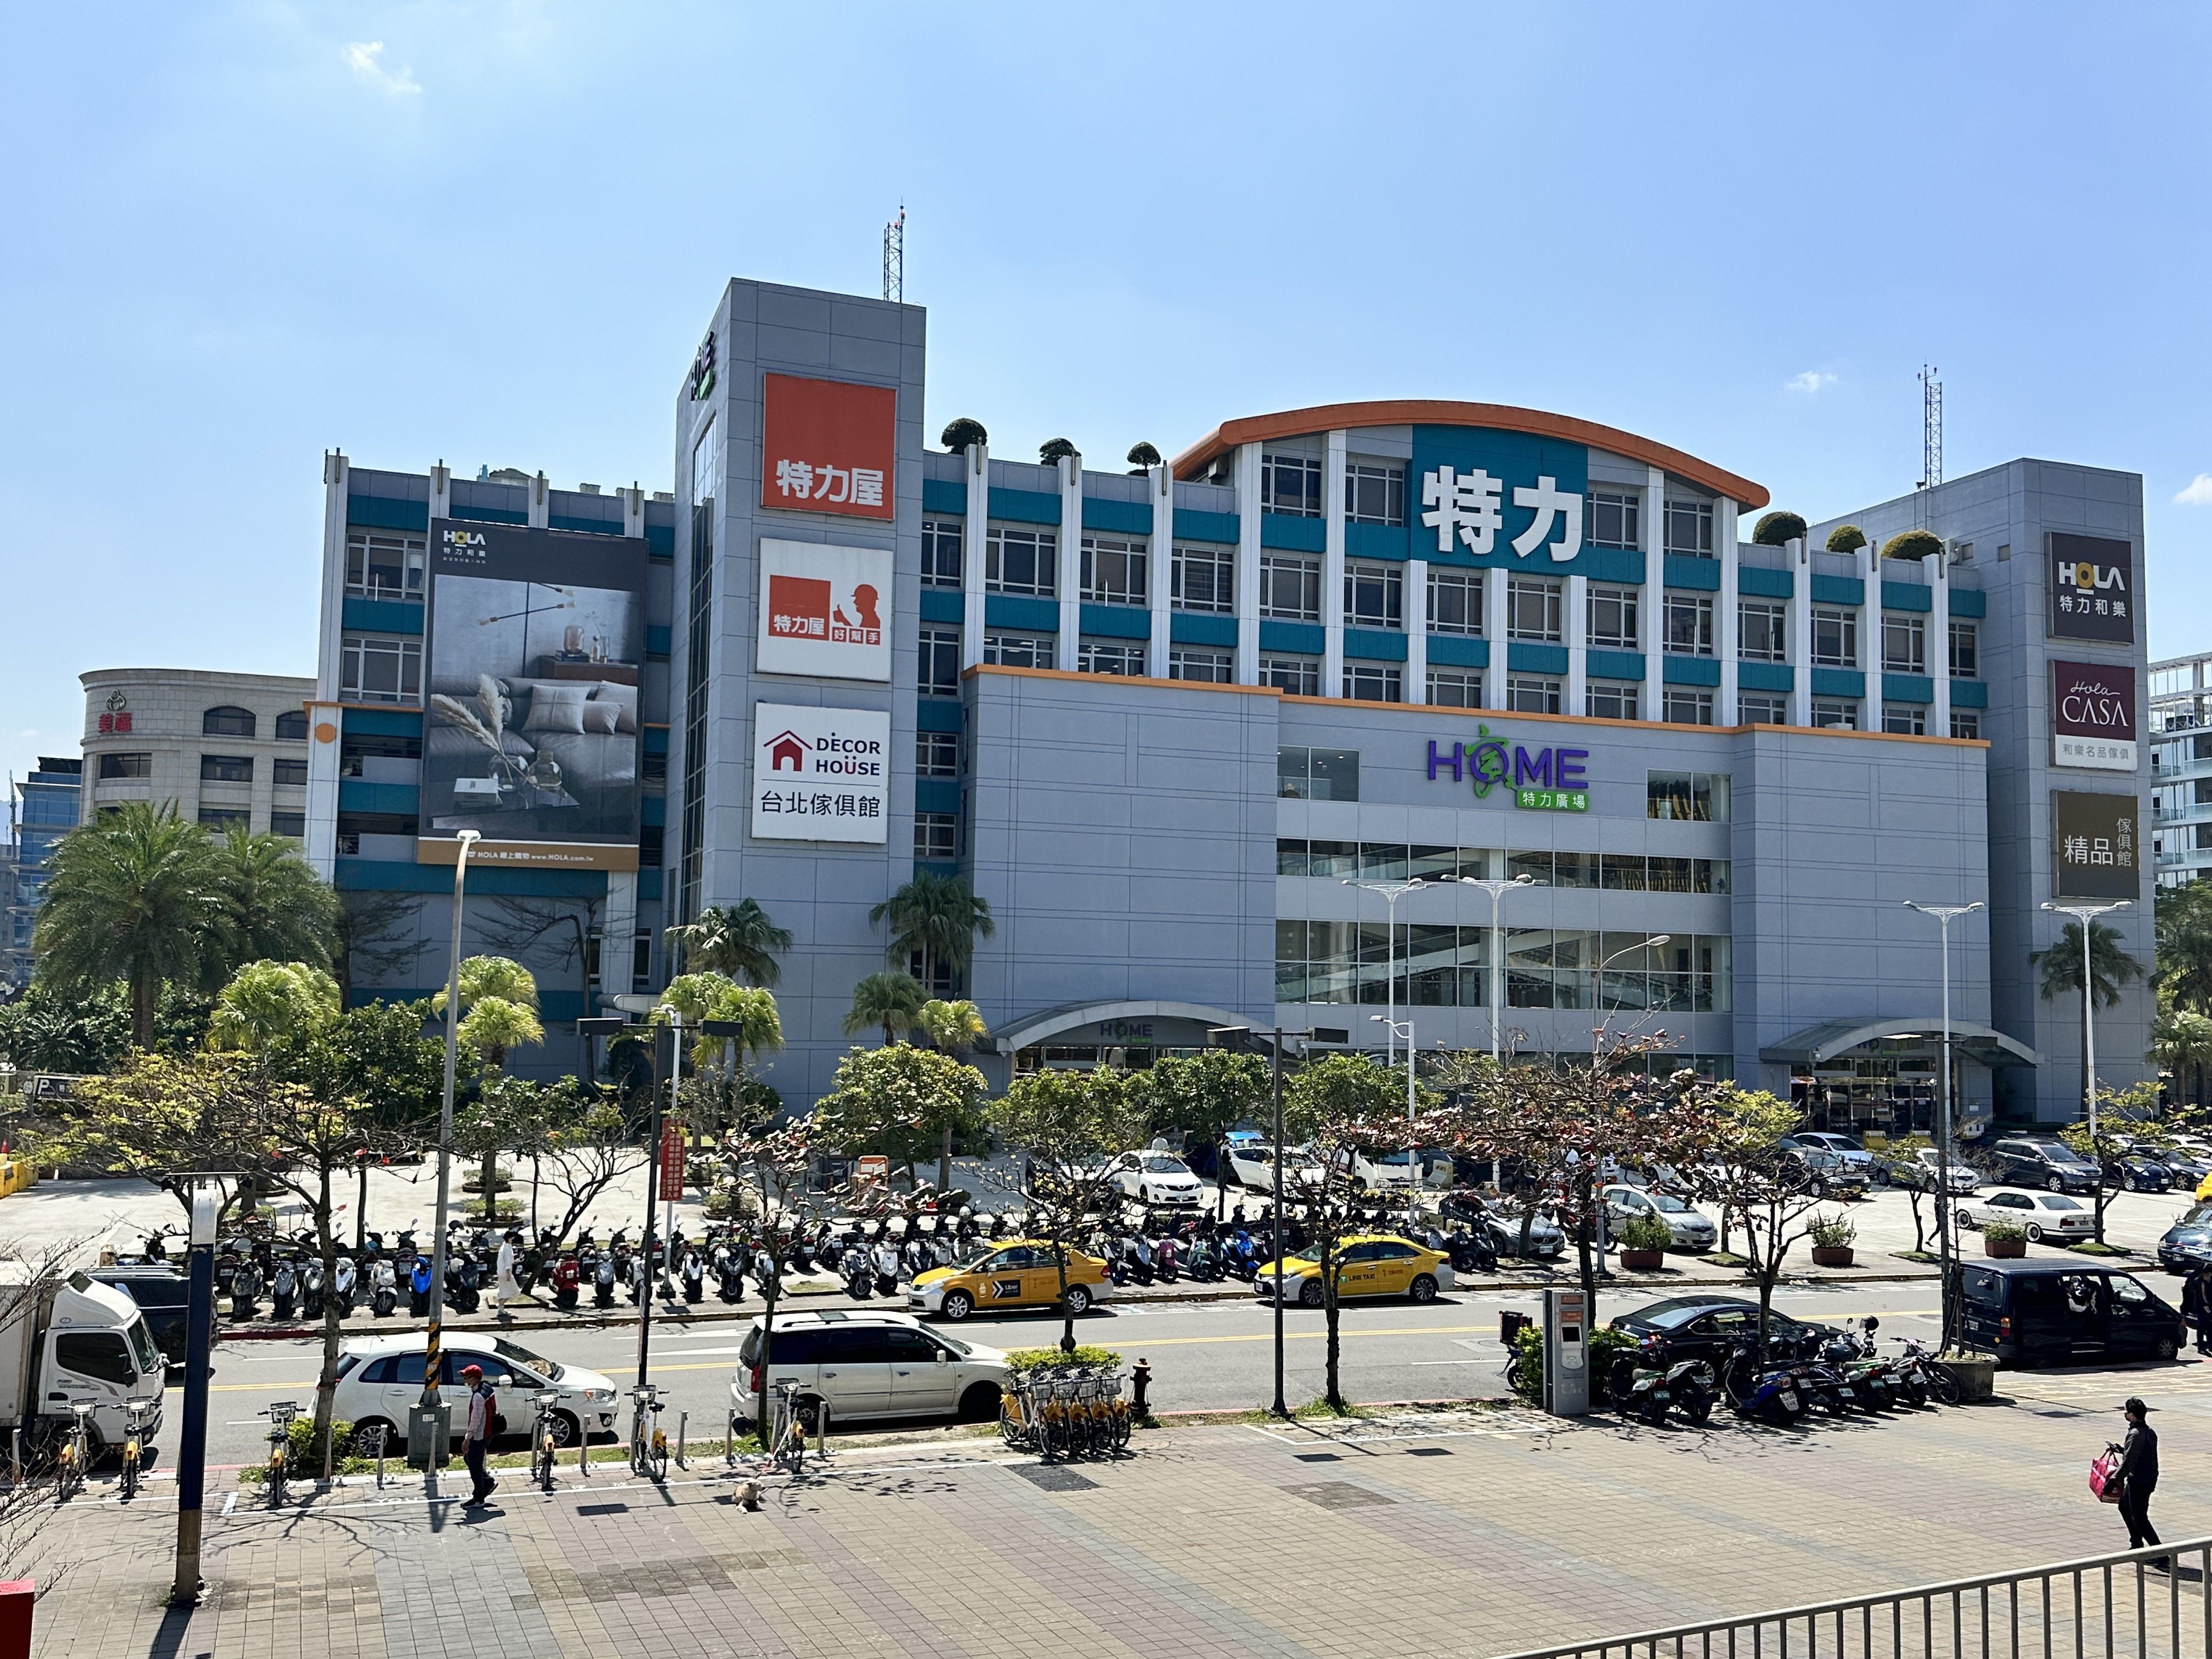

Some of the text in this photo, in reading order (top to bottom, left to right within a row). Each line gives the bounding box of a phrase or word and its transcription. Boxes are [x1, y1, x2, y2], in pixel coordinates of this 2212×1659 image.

[776, 459, 884, 507] 特力屋
[1421, 465, 1583, 562] 特力
[443, 530, 486, 545] HOLA
[2058, 561, 2125, 591] HOLA
[2059, 595, 2126, 617] 特力和樂
[774, 614, 825, 635] 特力屋
[2070, 680, 2121, 696] Hola
[2062, 696, 2129, 727] CASA
[1428, 740, 1589, 789] HOME
[2063, 744, 2129, 760] 和樂名品傢俱
[761, 790, 881, 817] 台北傢俱館
[1522, 792, 1585, 809] 特力廣場
[2064, 834, 2113, 866] 精品
[2116, 817, 2132, 867] 傢俱館
[37, 1079, 50, 1095] P
